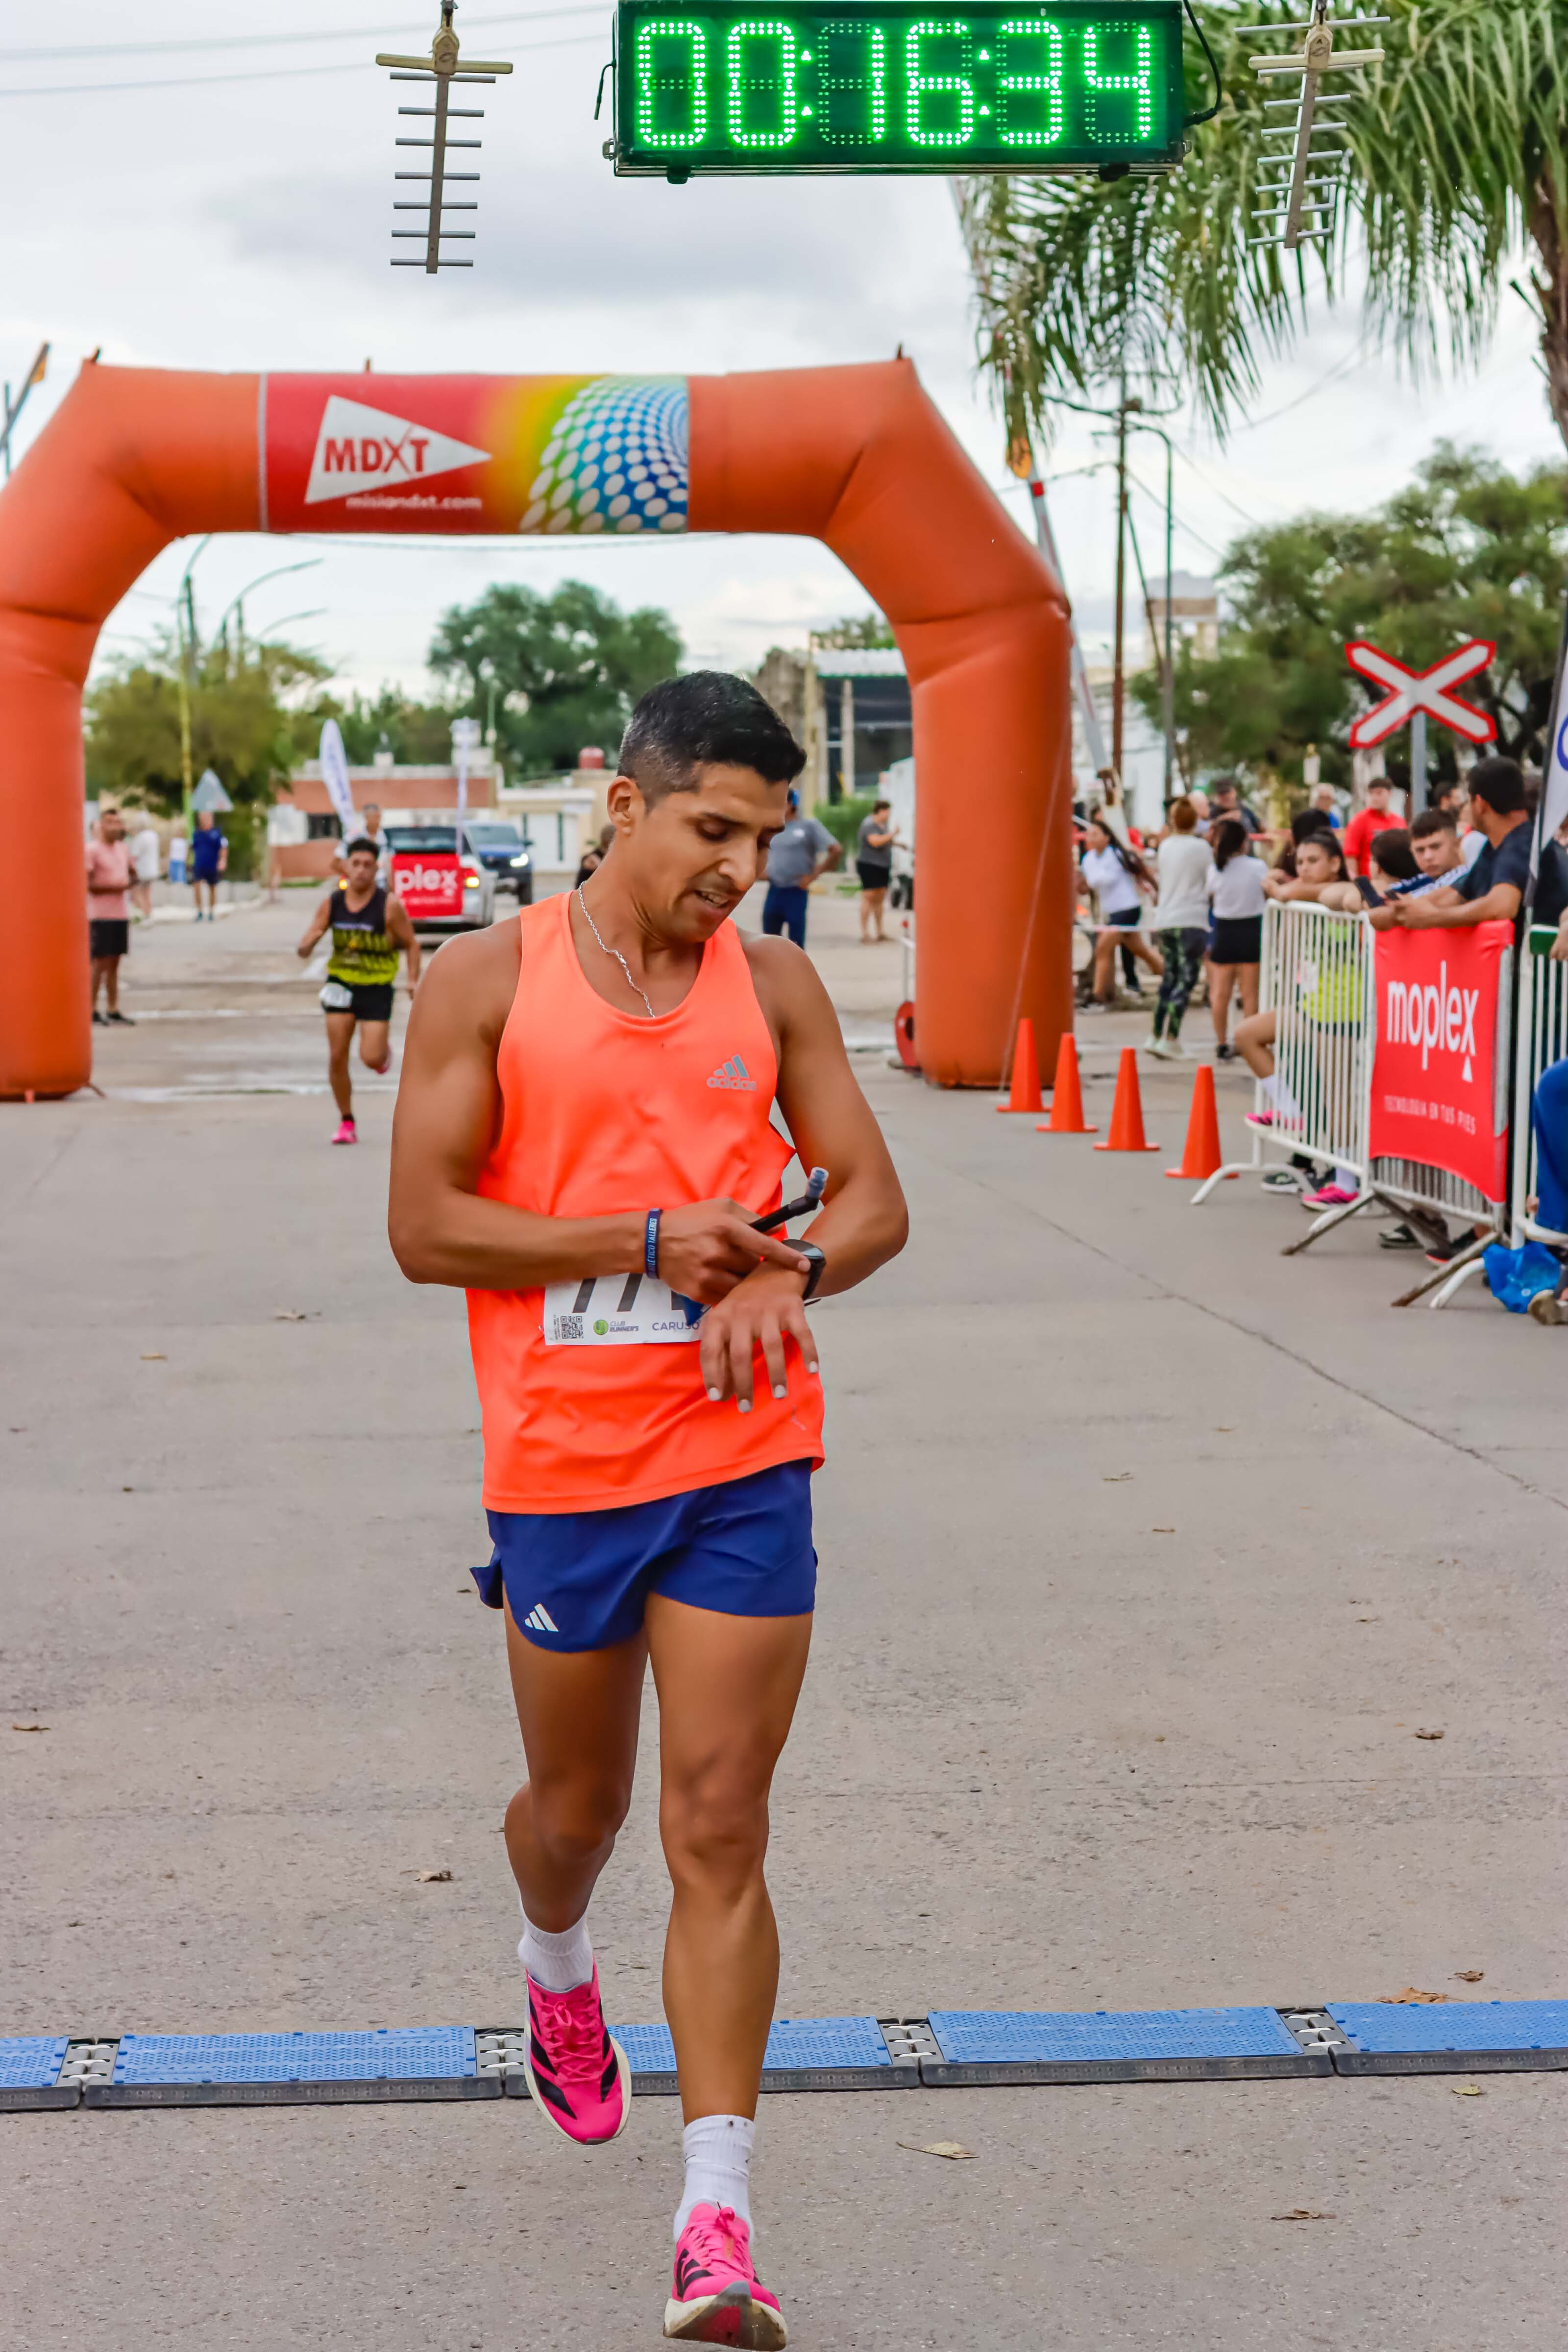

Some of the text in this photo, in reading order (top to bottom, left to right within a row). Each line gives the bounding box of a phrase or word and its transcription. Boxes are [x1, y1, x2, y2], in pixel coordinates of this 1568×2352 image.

[637, 21, 1152, 147] 00:16:34
[324, 436, 429, 473] MDXT
[1387, 959, 1479, 1071] moplex
[707, 1077, 757, 1091] adidas
